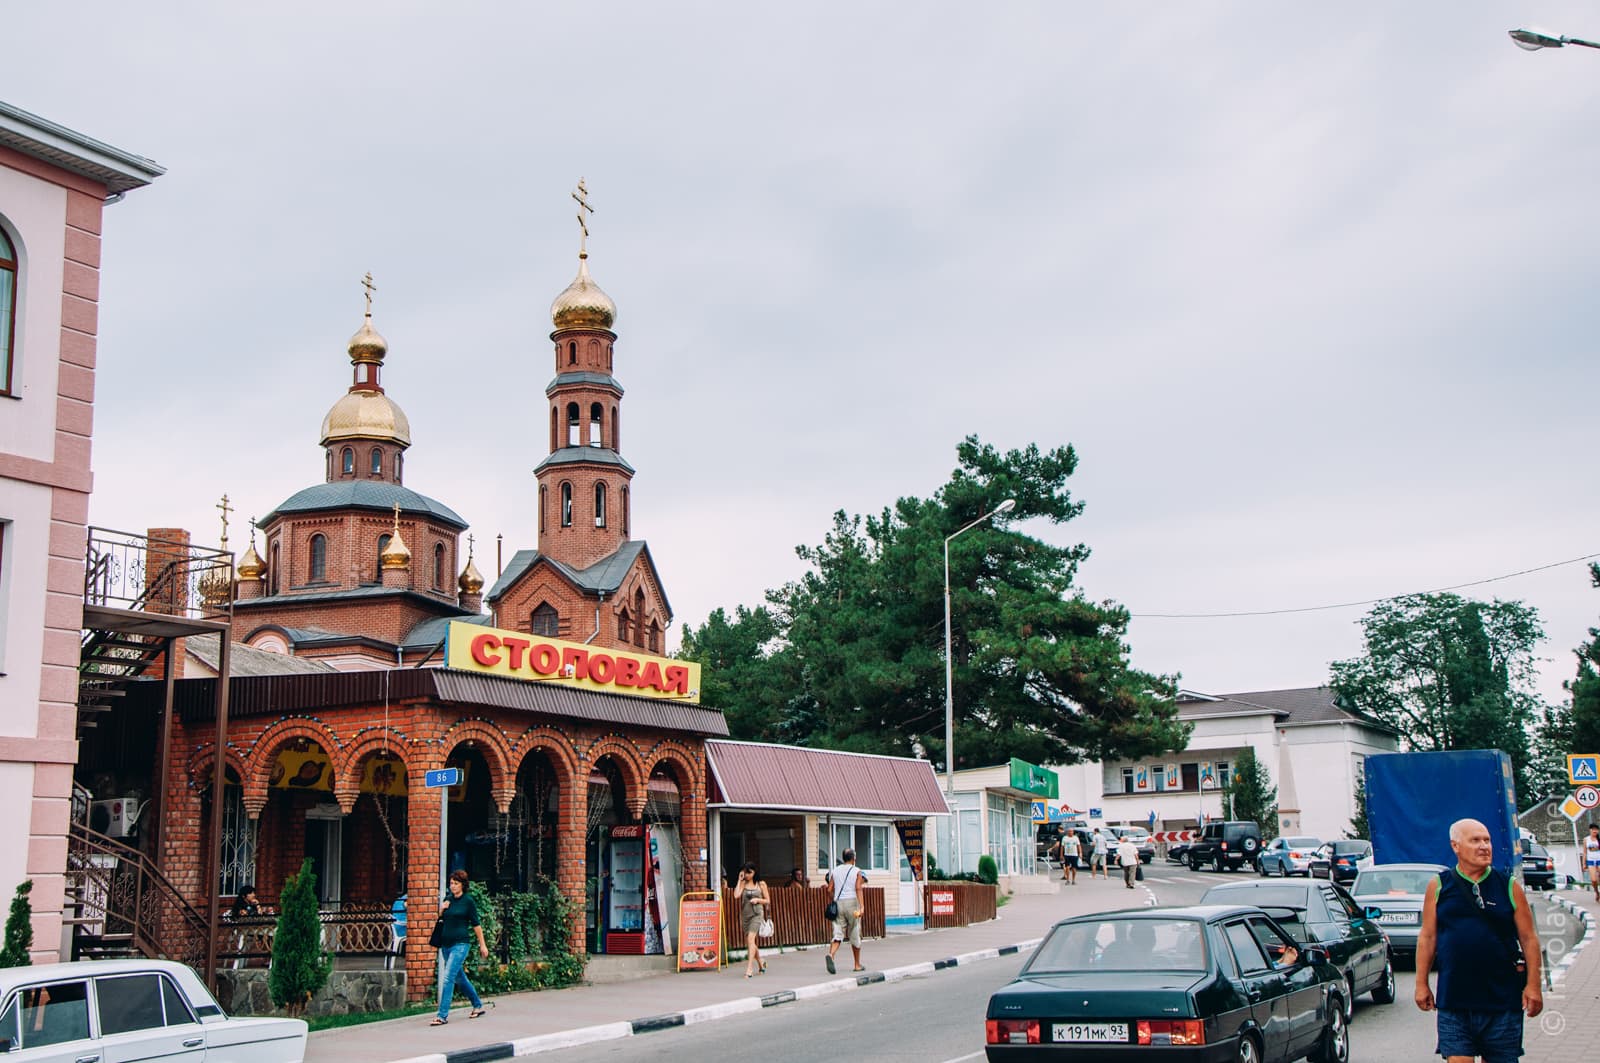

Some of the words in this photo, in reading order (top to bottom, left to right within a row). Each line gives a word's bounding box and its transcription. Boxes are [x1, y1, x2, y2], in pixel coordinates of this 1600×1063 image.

[471, 634, 688, 694] СТОЛОВАЯ
[436, 772, 447, 782] 86
[1579, 791, 1595, 801] 40
